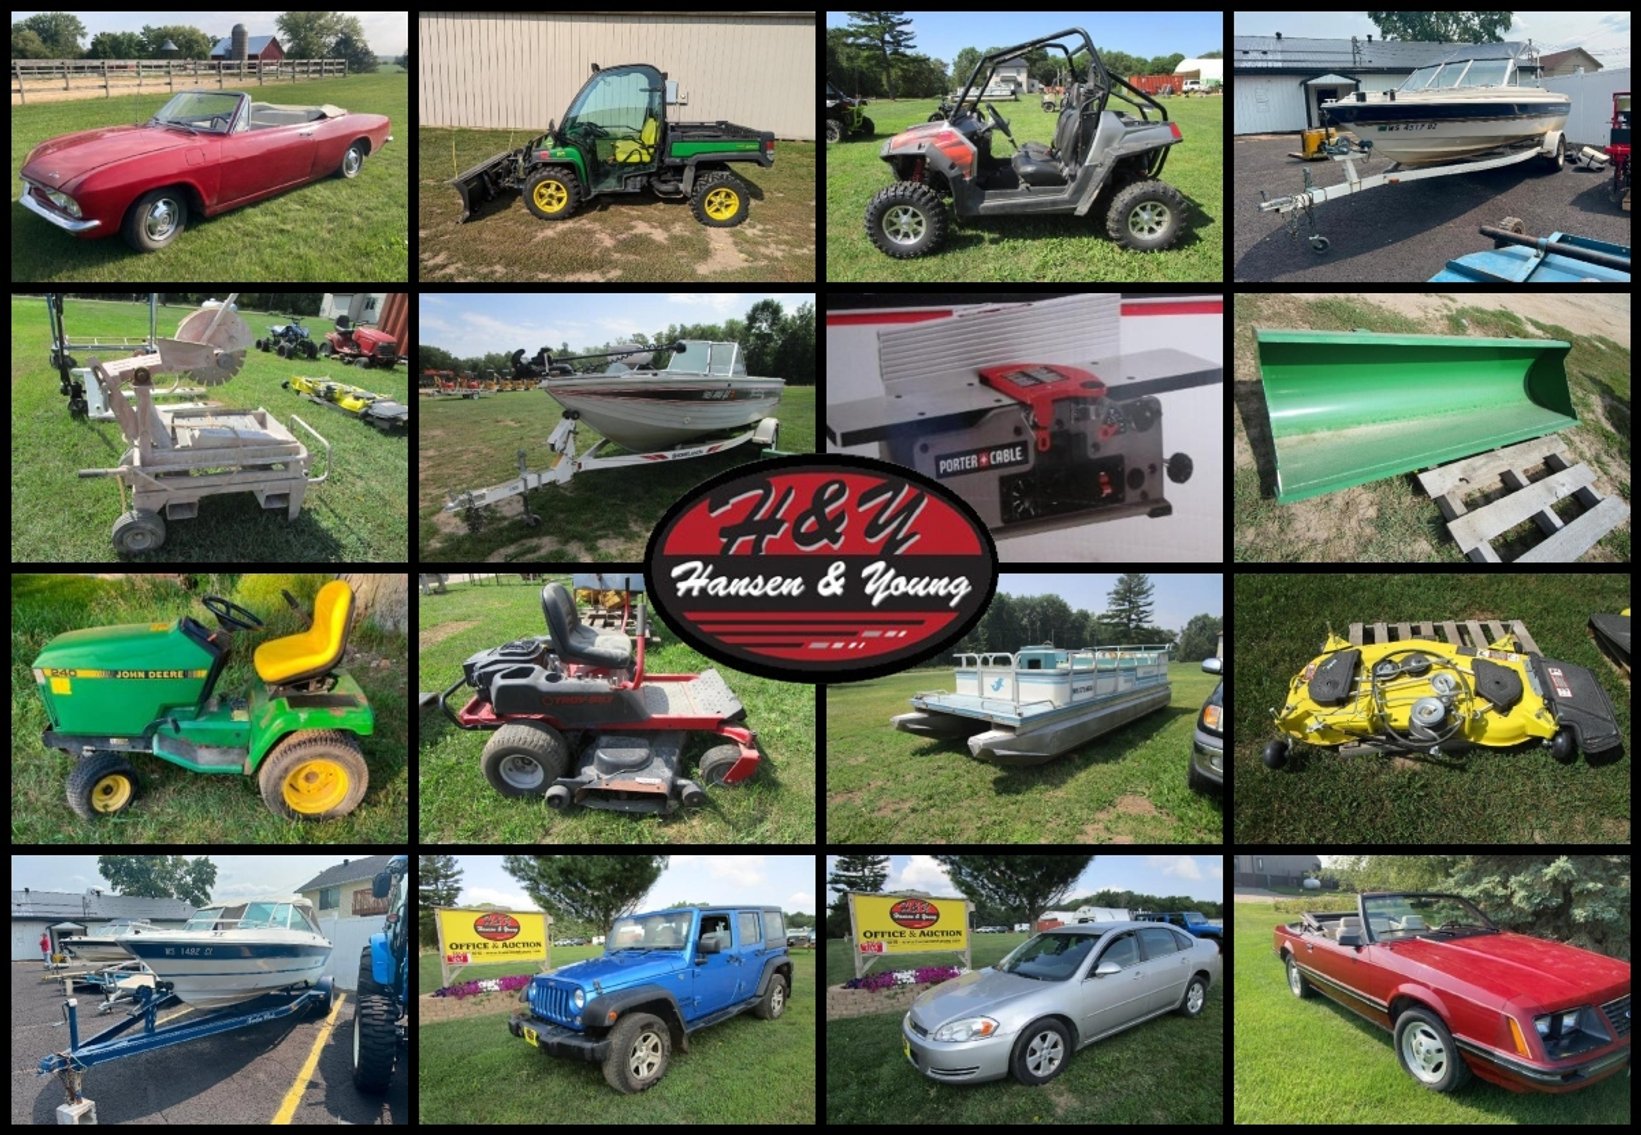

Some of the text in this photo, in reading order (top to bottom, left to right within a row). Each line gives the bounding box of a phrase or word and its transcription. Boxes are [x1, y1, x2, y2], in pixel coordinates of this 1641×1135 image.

[939, 446, 1023, 474] PORTER CABLE
[116, 670, 146, 679] JOHN
[148, 670, 184, 679] DEERE
[863, 929, 907, 939] OFFICE
[918, 929, 962, 938] AUCTION
[449, 942, 490, 951] OFFICE
[501, 941, 542, 950] AUCTION
